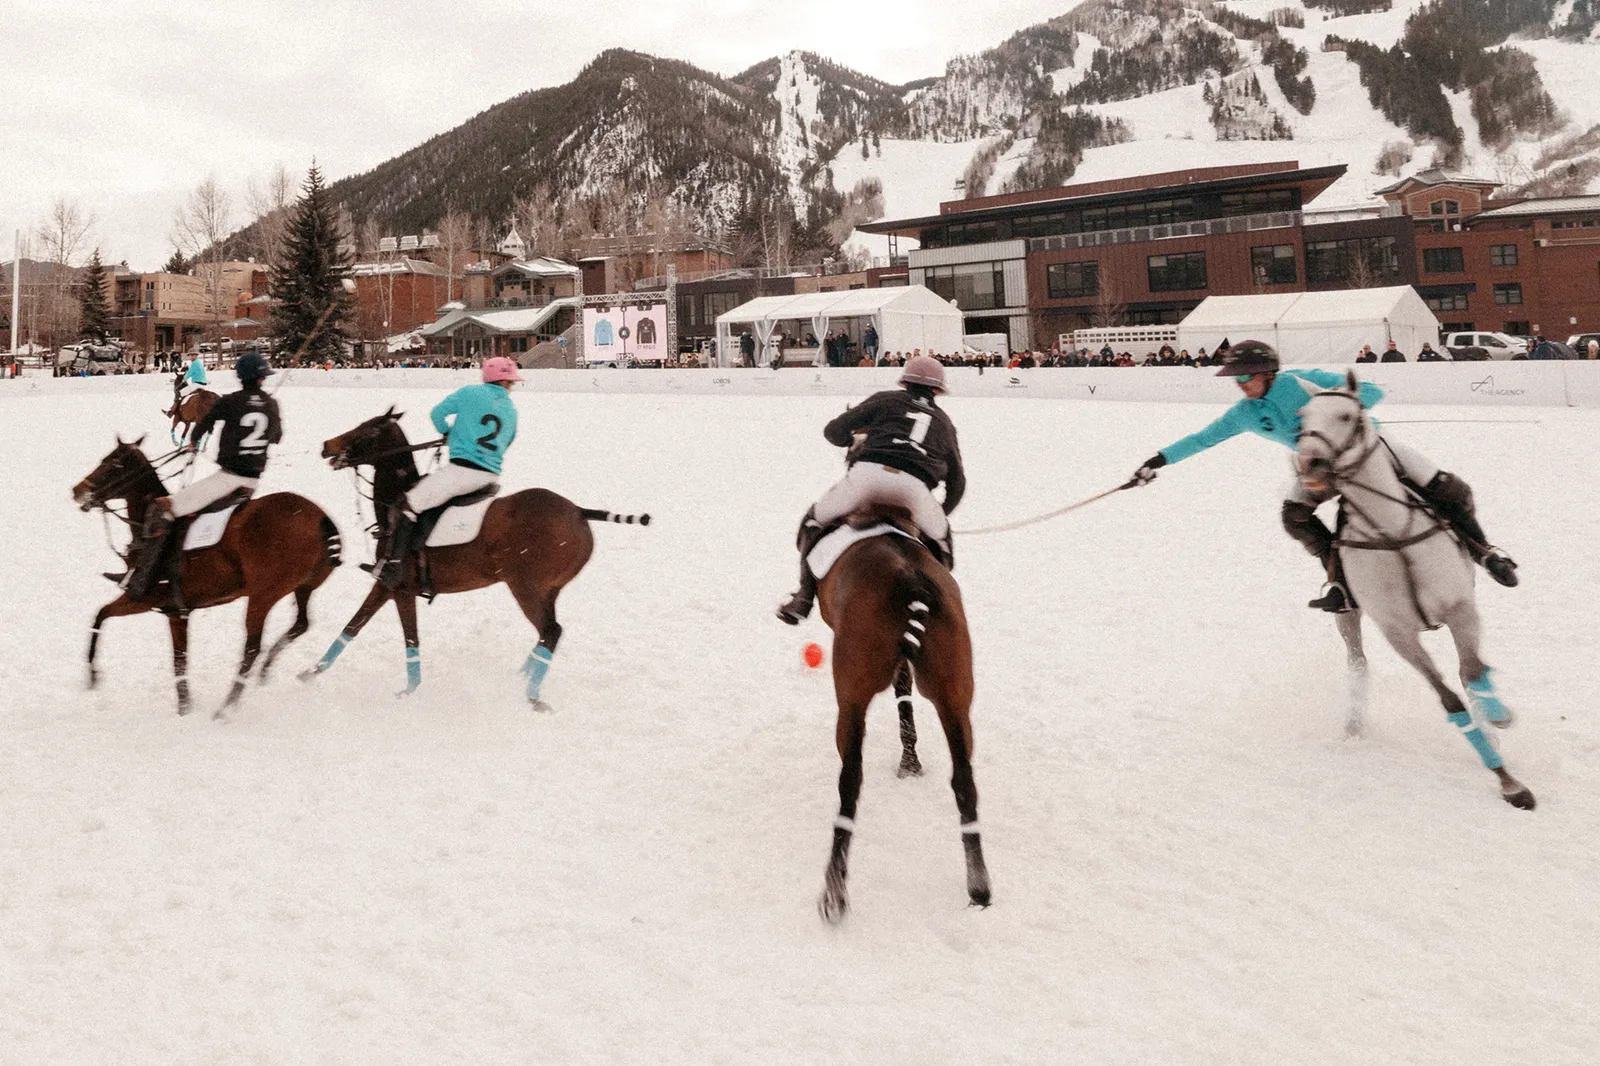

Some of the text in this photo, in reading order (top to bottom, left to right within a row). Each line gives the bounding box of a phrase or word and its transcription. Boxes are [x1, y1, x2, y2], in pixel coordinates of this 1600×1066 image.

[1088, 385, 1096, 394] V
[239, 411, 269, 448] 2
[476, 413, 503, 452] 2
[905, 411, 933, 444] 1
